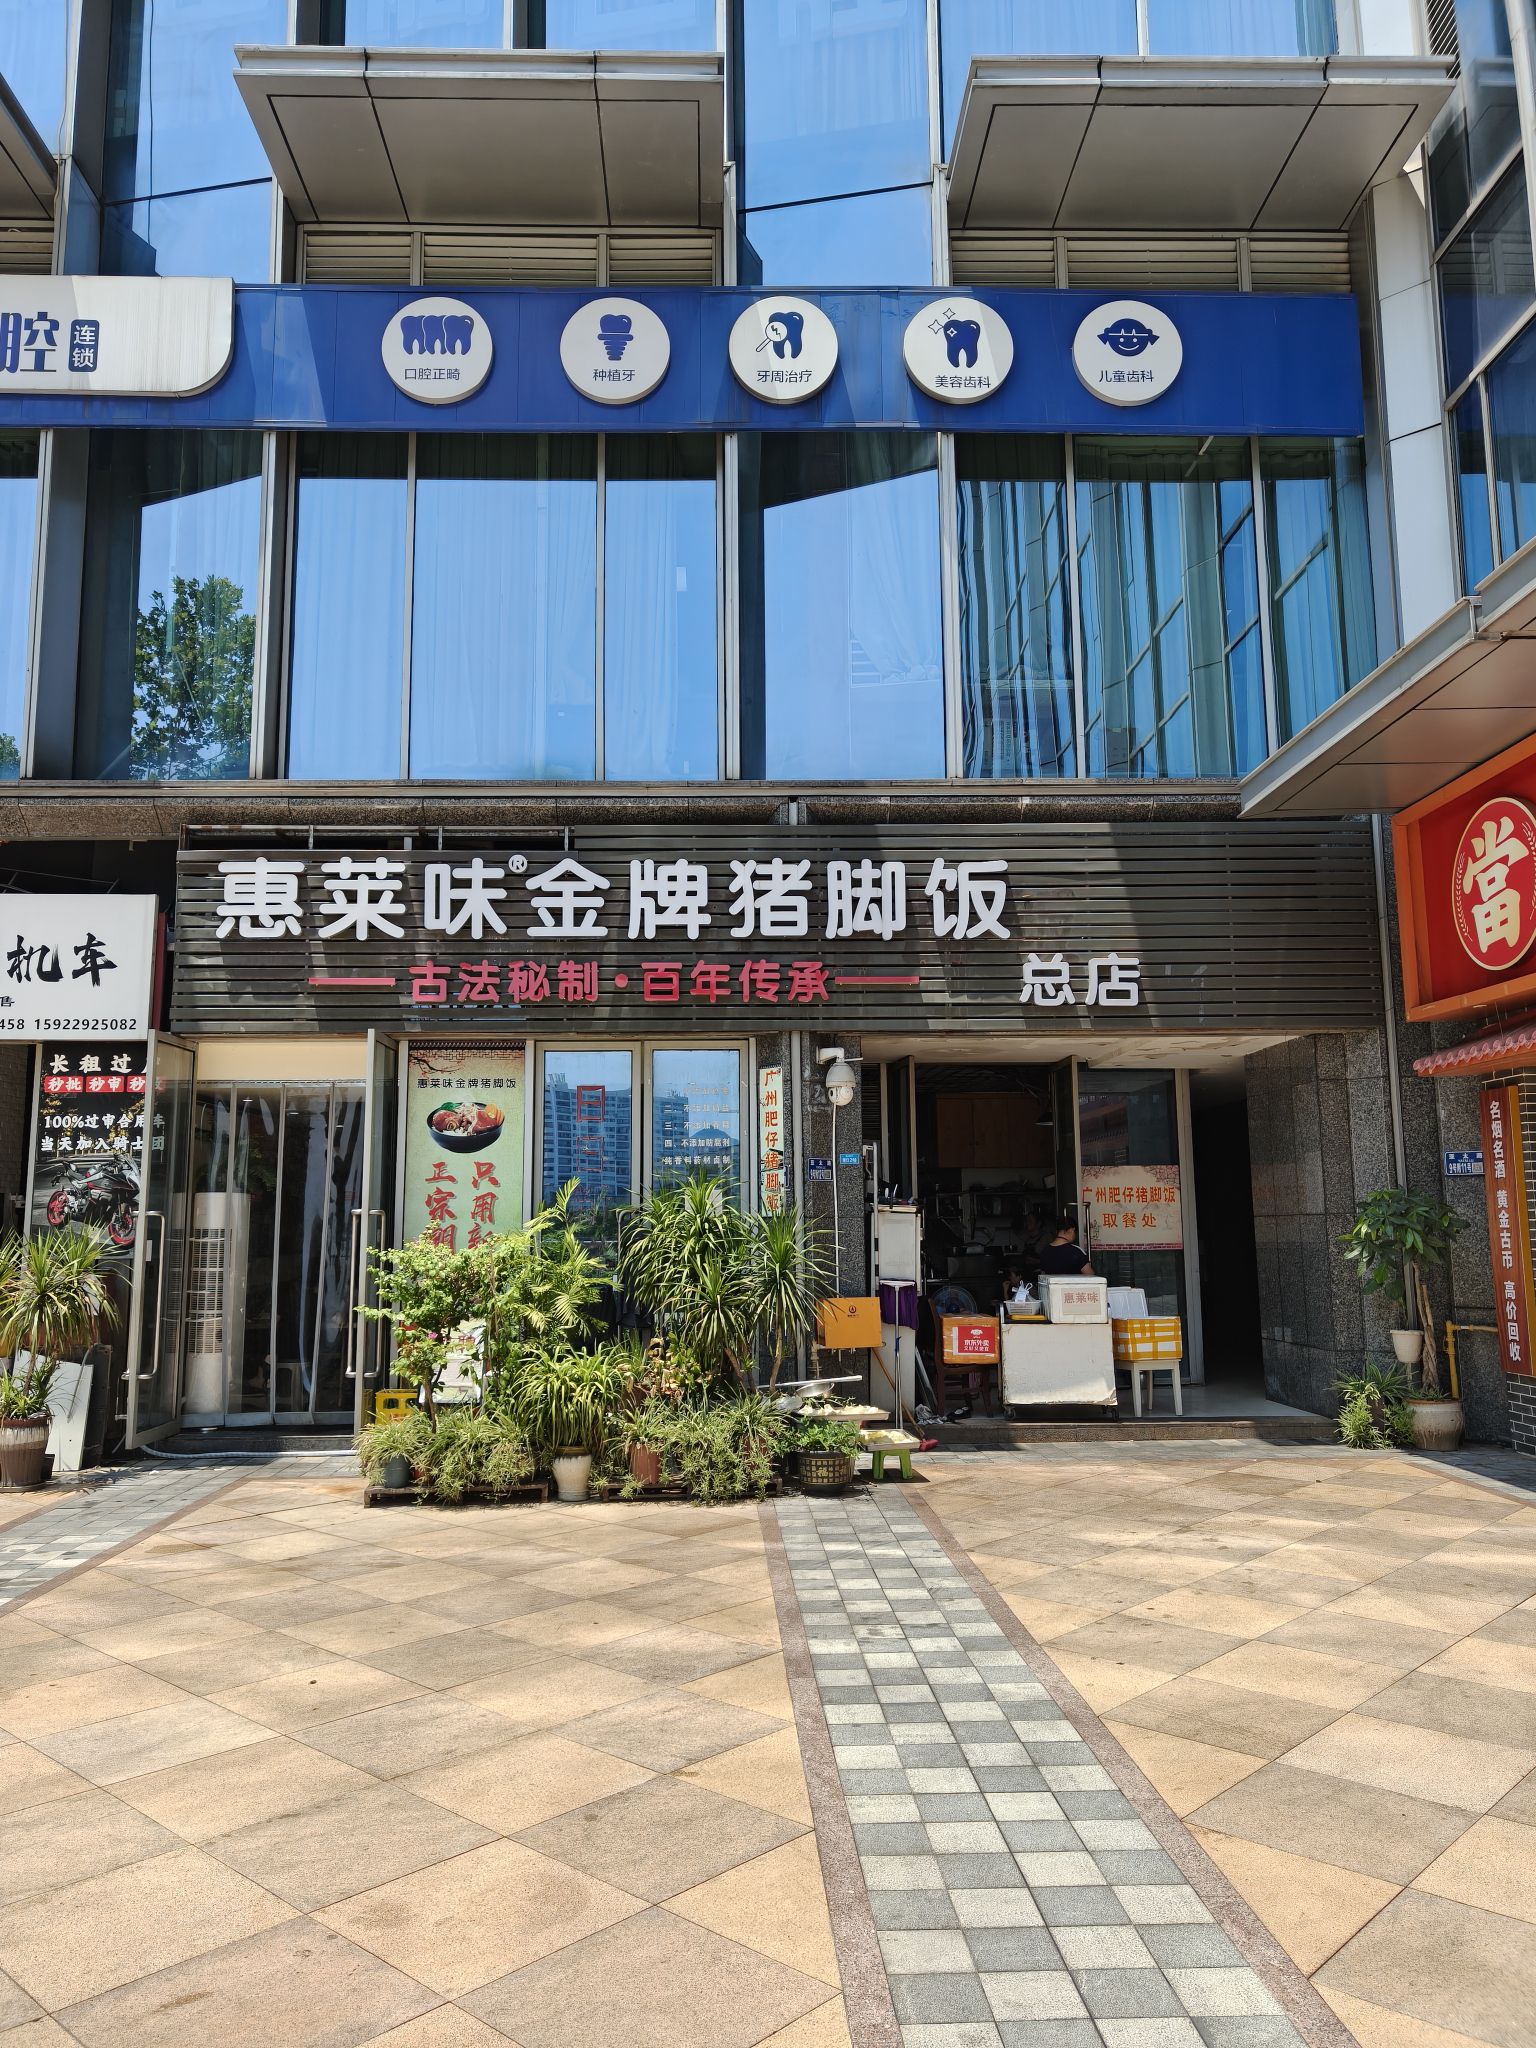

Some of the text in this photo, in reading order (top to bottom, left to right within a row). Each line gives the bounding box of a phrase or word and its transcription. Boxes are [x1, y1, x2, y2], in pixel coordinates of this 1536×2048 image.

[72, 324, 96, 368] 连锁
[404, 367, 461, 381] 口腔正畸
[592, 368, 636, 382] 种植牙
[756, 369, 812, 383] 牙周治疗
[934, 375, 991, 389] 美容齿科
[1098, 369, 1154, 383] 儿童齿科
[1462, 815, 1530, 954] 當
[7, 932, 118, 988] 机车
[1019, 953, 1140, 1007] 总店
[34, 1018, 137, 1031] 15922925082
[50, 1054, 147, 1074] 长租过
[48, 1077, 82, 1091] 秒批
[89, 1077, 122, 1091] 秒审
[1082, 1185, 1176, 1203] 广州肥仔猪脚饭
[1102, 1212, 1157, 1228] 取餐处
[1490, 1100, 1521, 1361] 名烟名酒 黄金古币 高价回收
